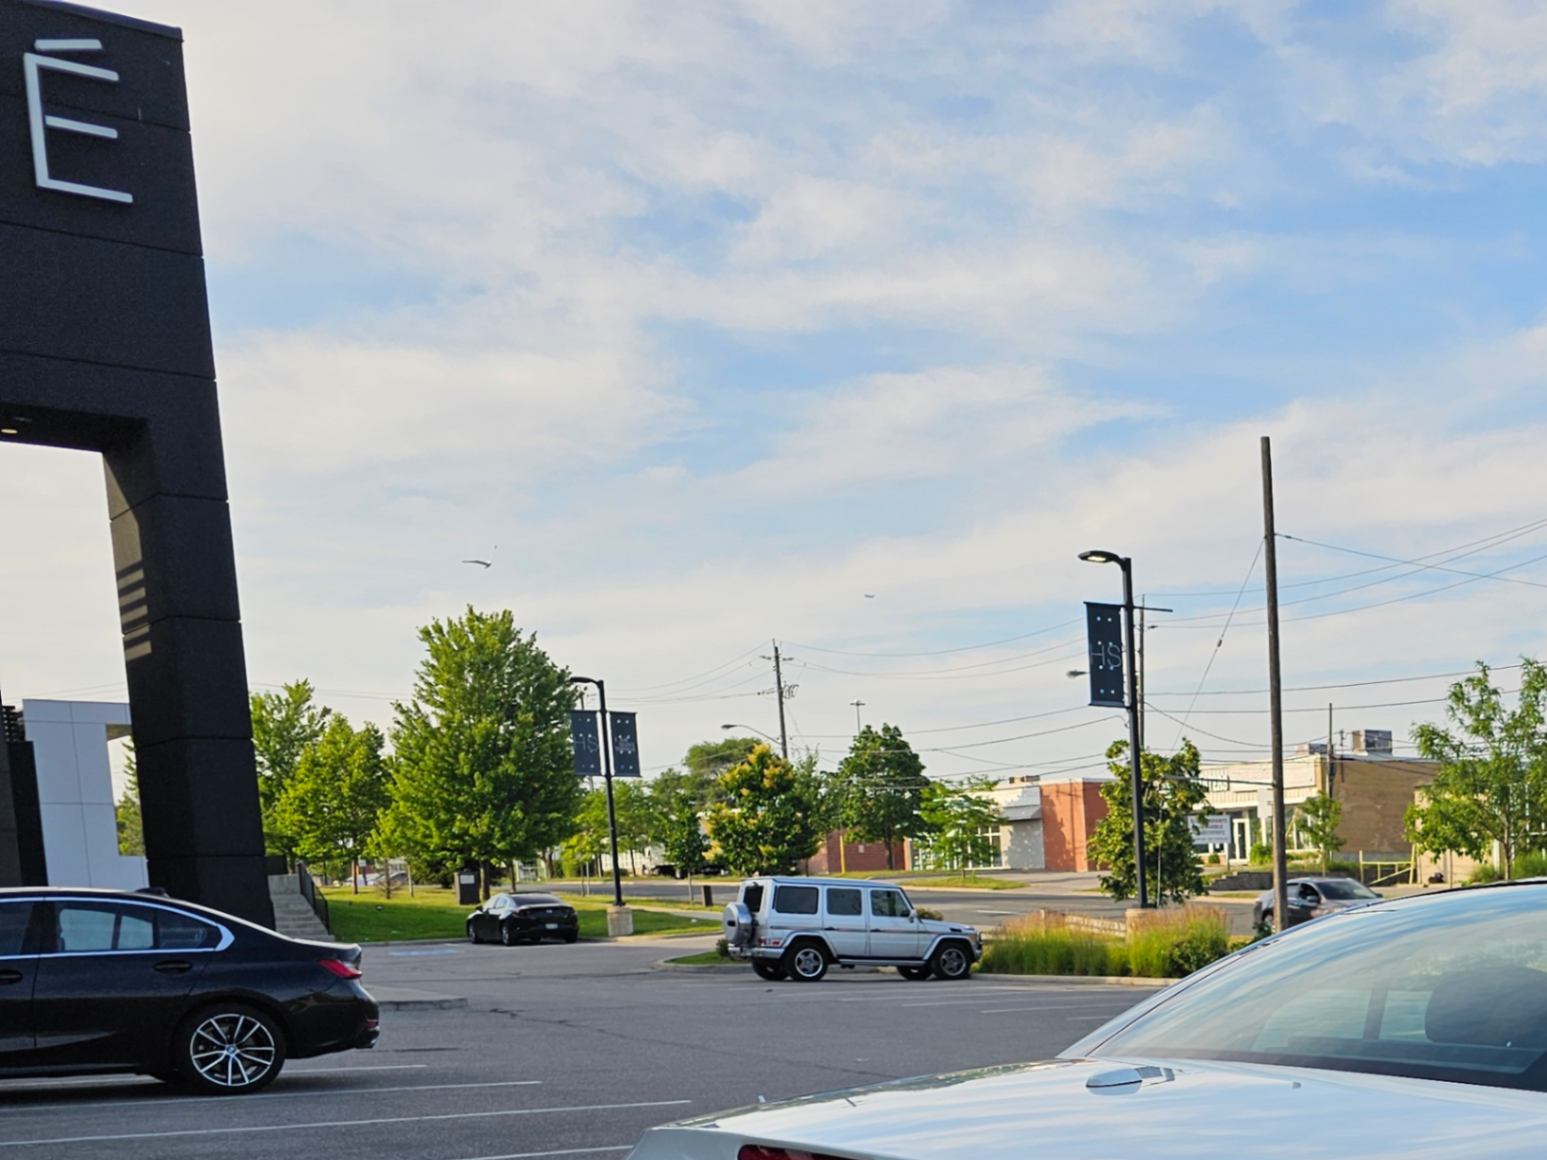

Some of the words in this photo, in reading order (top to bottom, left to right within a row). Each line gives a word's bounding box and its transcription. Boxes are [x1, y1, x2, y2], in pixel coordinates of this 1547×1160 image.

[23, 38, 133, 203] É
[1090, 644, 1122, 668] HS
[574, 736, 599, 752] HS
